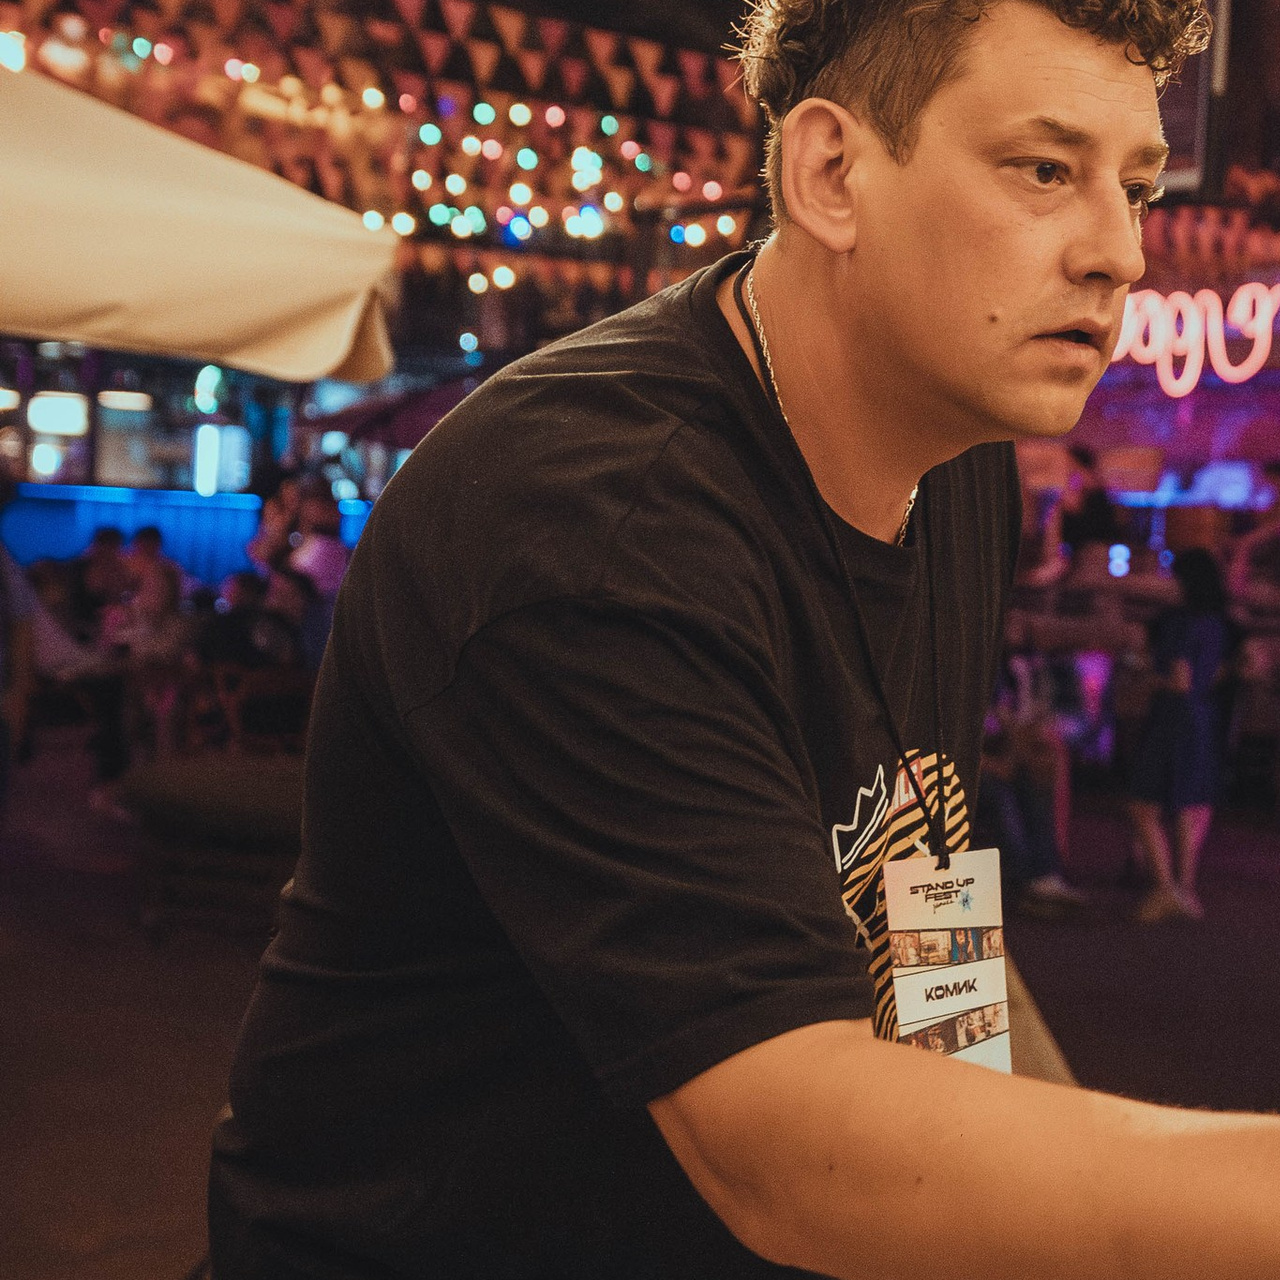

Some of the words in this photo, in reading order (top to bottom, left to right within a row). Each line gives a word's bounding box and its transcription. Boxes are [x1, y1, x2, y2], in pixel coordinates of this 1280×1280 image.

[909, 880, 955, 895] STAND
[956, 877, 975, 888] UP
[924, 889, 961, 903] FEST
[924, 977, 978, 1002] КОМИК
